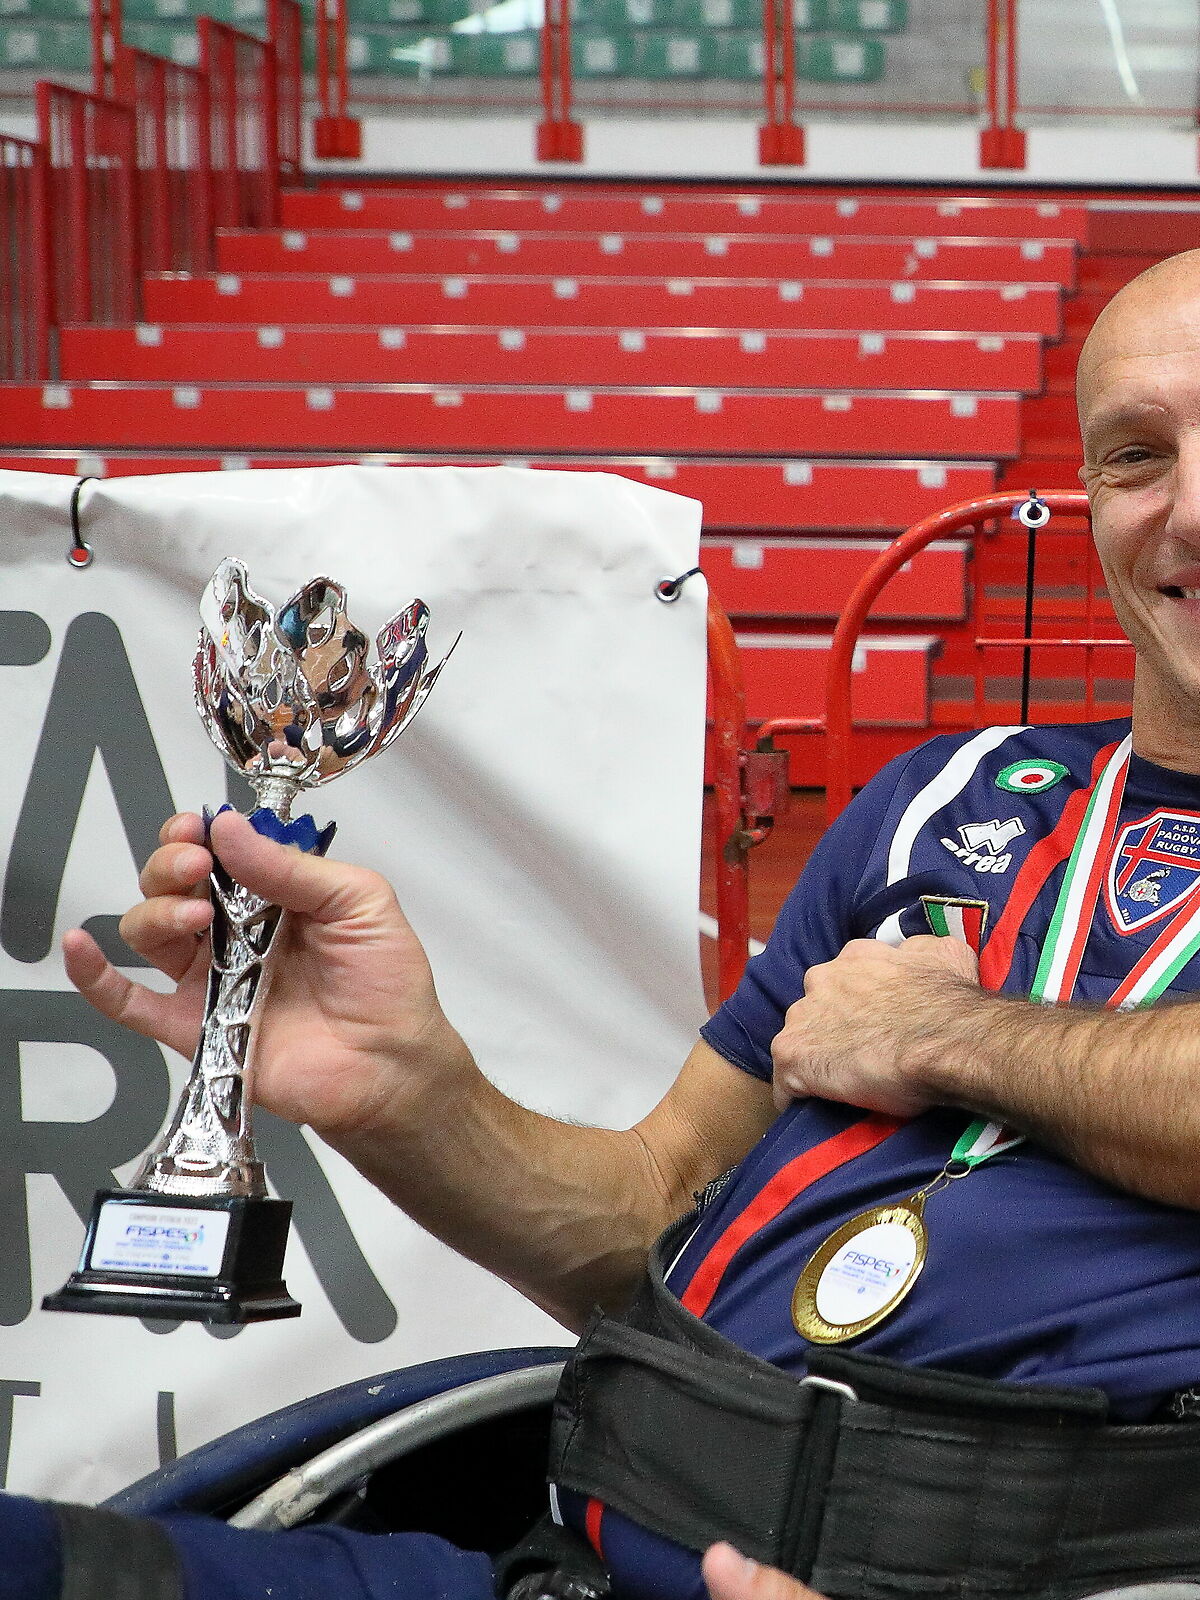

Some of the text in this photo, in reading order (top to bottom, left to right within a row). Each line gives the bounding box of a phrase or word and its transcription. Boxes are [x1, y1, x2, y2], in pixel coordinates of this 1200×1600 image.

[1172, 824, 1198, 834] A.S.D.
[1156, 841, 1198, 855] RUGBY
[843, 1251, 895, 1277] FISPES
